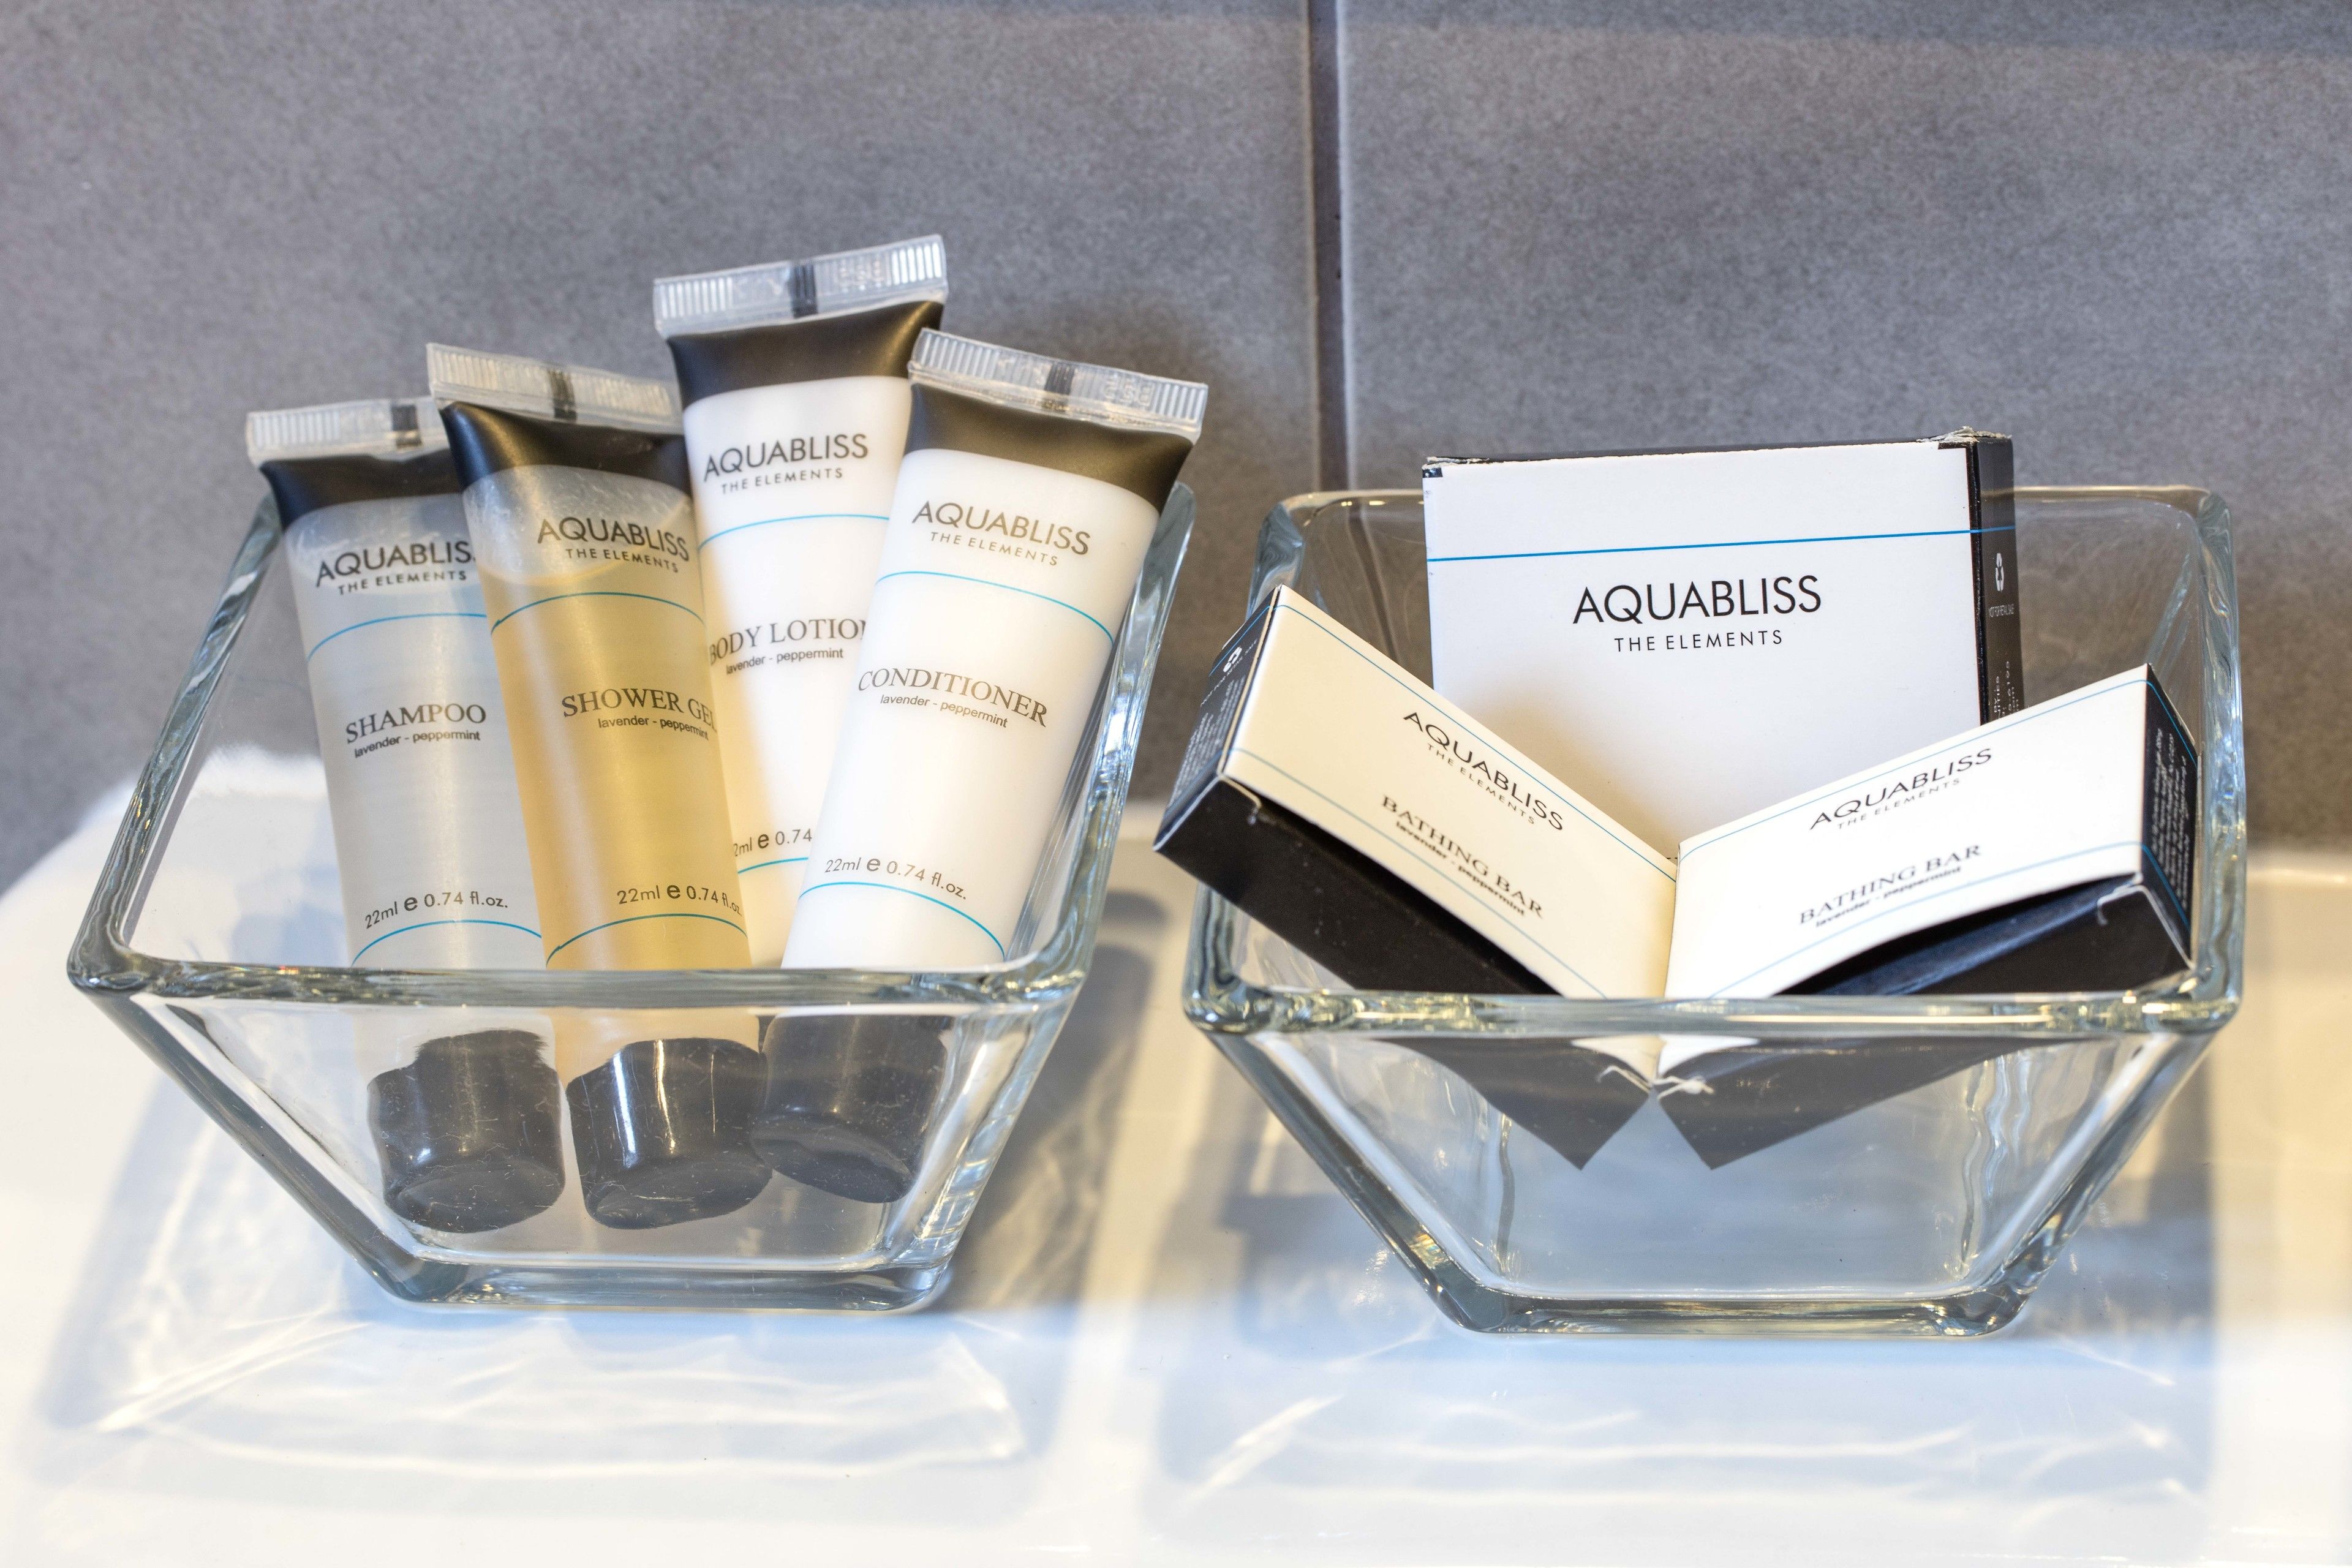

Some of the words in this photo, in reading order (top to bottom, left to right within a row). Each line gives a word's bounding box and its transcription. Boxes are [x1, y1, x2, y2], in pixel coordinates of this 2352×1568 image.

[704, 433, 869, 482] AQUABLISS
[721, 478, 748, 494] THE
[754, 467, 843, 487] ELEMENTS
[537, 516, 690, 562] AQUABLISS
[911, 500, 1091, 556] AQUABLISS
[315, 540, 476, 588] AQUABLIS
[565, 548, 598, 559] THE
[603, 549, 679, 573] ELEMENTS
[930, 532, 962, 545] THE
[968, 537, 1058, 567] ELEMENTS
[337, 578, 368, 596] THE
[375, 570, 467, 587] ELEMENTS
[1572, 575, 1822, 625] AQUABLISS
[709, 625, 761, 666] BODY
[1614, 636, 1656, 652] THE
[1666, 629, 1782, 650] ELEMENTS
[725, 656, 766, 676] lavender
[776, 647, 844, 665] peppermint
[561, 688, 685, 718] SHOWER
[858, 668, 1047, 728] CONDITIONER
[880, 694, 931, 706] lavender
[940, 701, 1008, 728] peppermint
[345, 703, 487, 745] SHAMPOO
[354, 736, 401, 759] lavender
[412, 729, 481, 744] peppermint
[598, 715, 650, 729] lavender
[659, 718, 709, 741] peppermint
[1403, 712, 1563, 831] AQUABLISS
[1427, 742, 1454, 767] THE
[1460, 766, 1540, 824] ELEMENTS
[1810, 748, 1992, 830] AQUABLISS
[1838, 813, 1867, 830] THE
[1874, 778, 1960, 816] ELEMENTS
[733, 836, 753, 857] 2ml
[775, 828, 813, 846] 0.74
[1382, 796, 1488, 876] BATHING
[1491, 875, 1542, 918] BAR
[824, 857, 862, 873] 22ml
[886, 861, 925, 882] 0.74
[1395, 821, 1447, 859] lavender
[1458, 865, 1525, 916] peppermint
[1800, 865, 1915, 924] BATHING
[1926, 845, 1980, 872] BAR
[364, 900, 398, 930] 22ml
[424, 891, 464, 908] 0.74
[616, 884, 661, 905] 22ml
[686, 885, 719, 904] 0.74
[1815, 899, 1870, 928] lavender
[1883, 865, 1961, 899] peppermint
